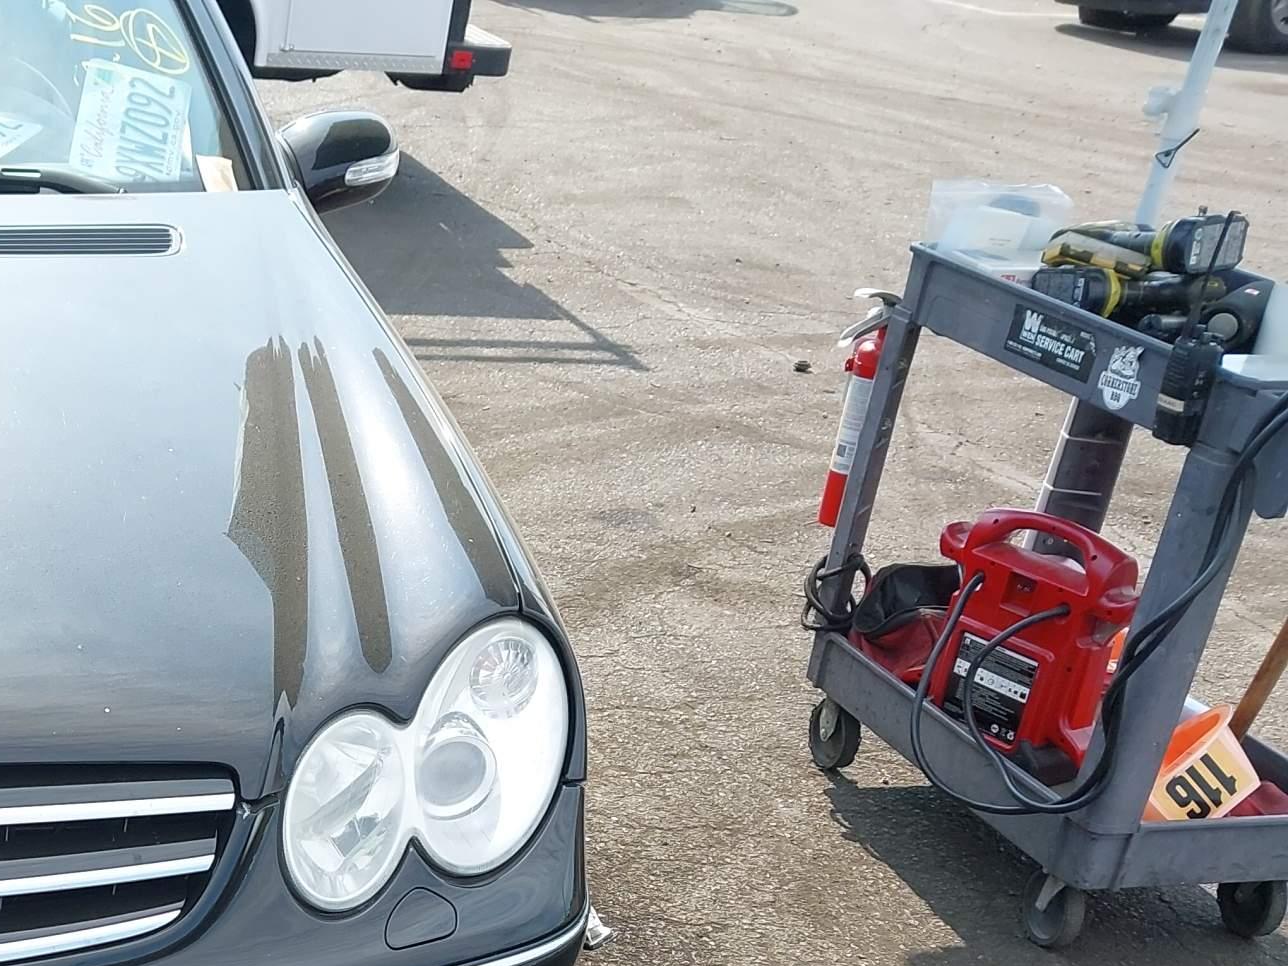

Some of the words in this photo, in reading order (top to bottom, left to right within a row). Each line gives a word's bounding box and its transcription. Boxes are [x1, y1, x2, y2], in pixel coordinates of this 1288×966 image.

[114, 76, 175, 181] 9XWZ092
[1035, 334, 1066, 356] SERVICE
[1063, 345, 1085, 363] CART
[1165, 753, 1237, 819] 116
